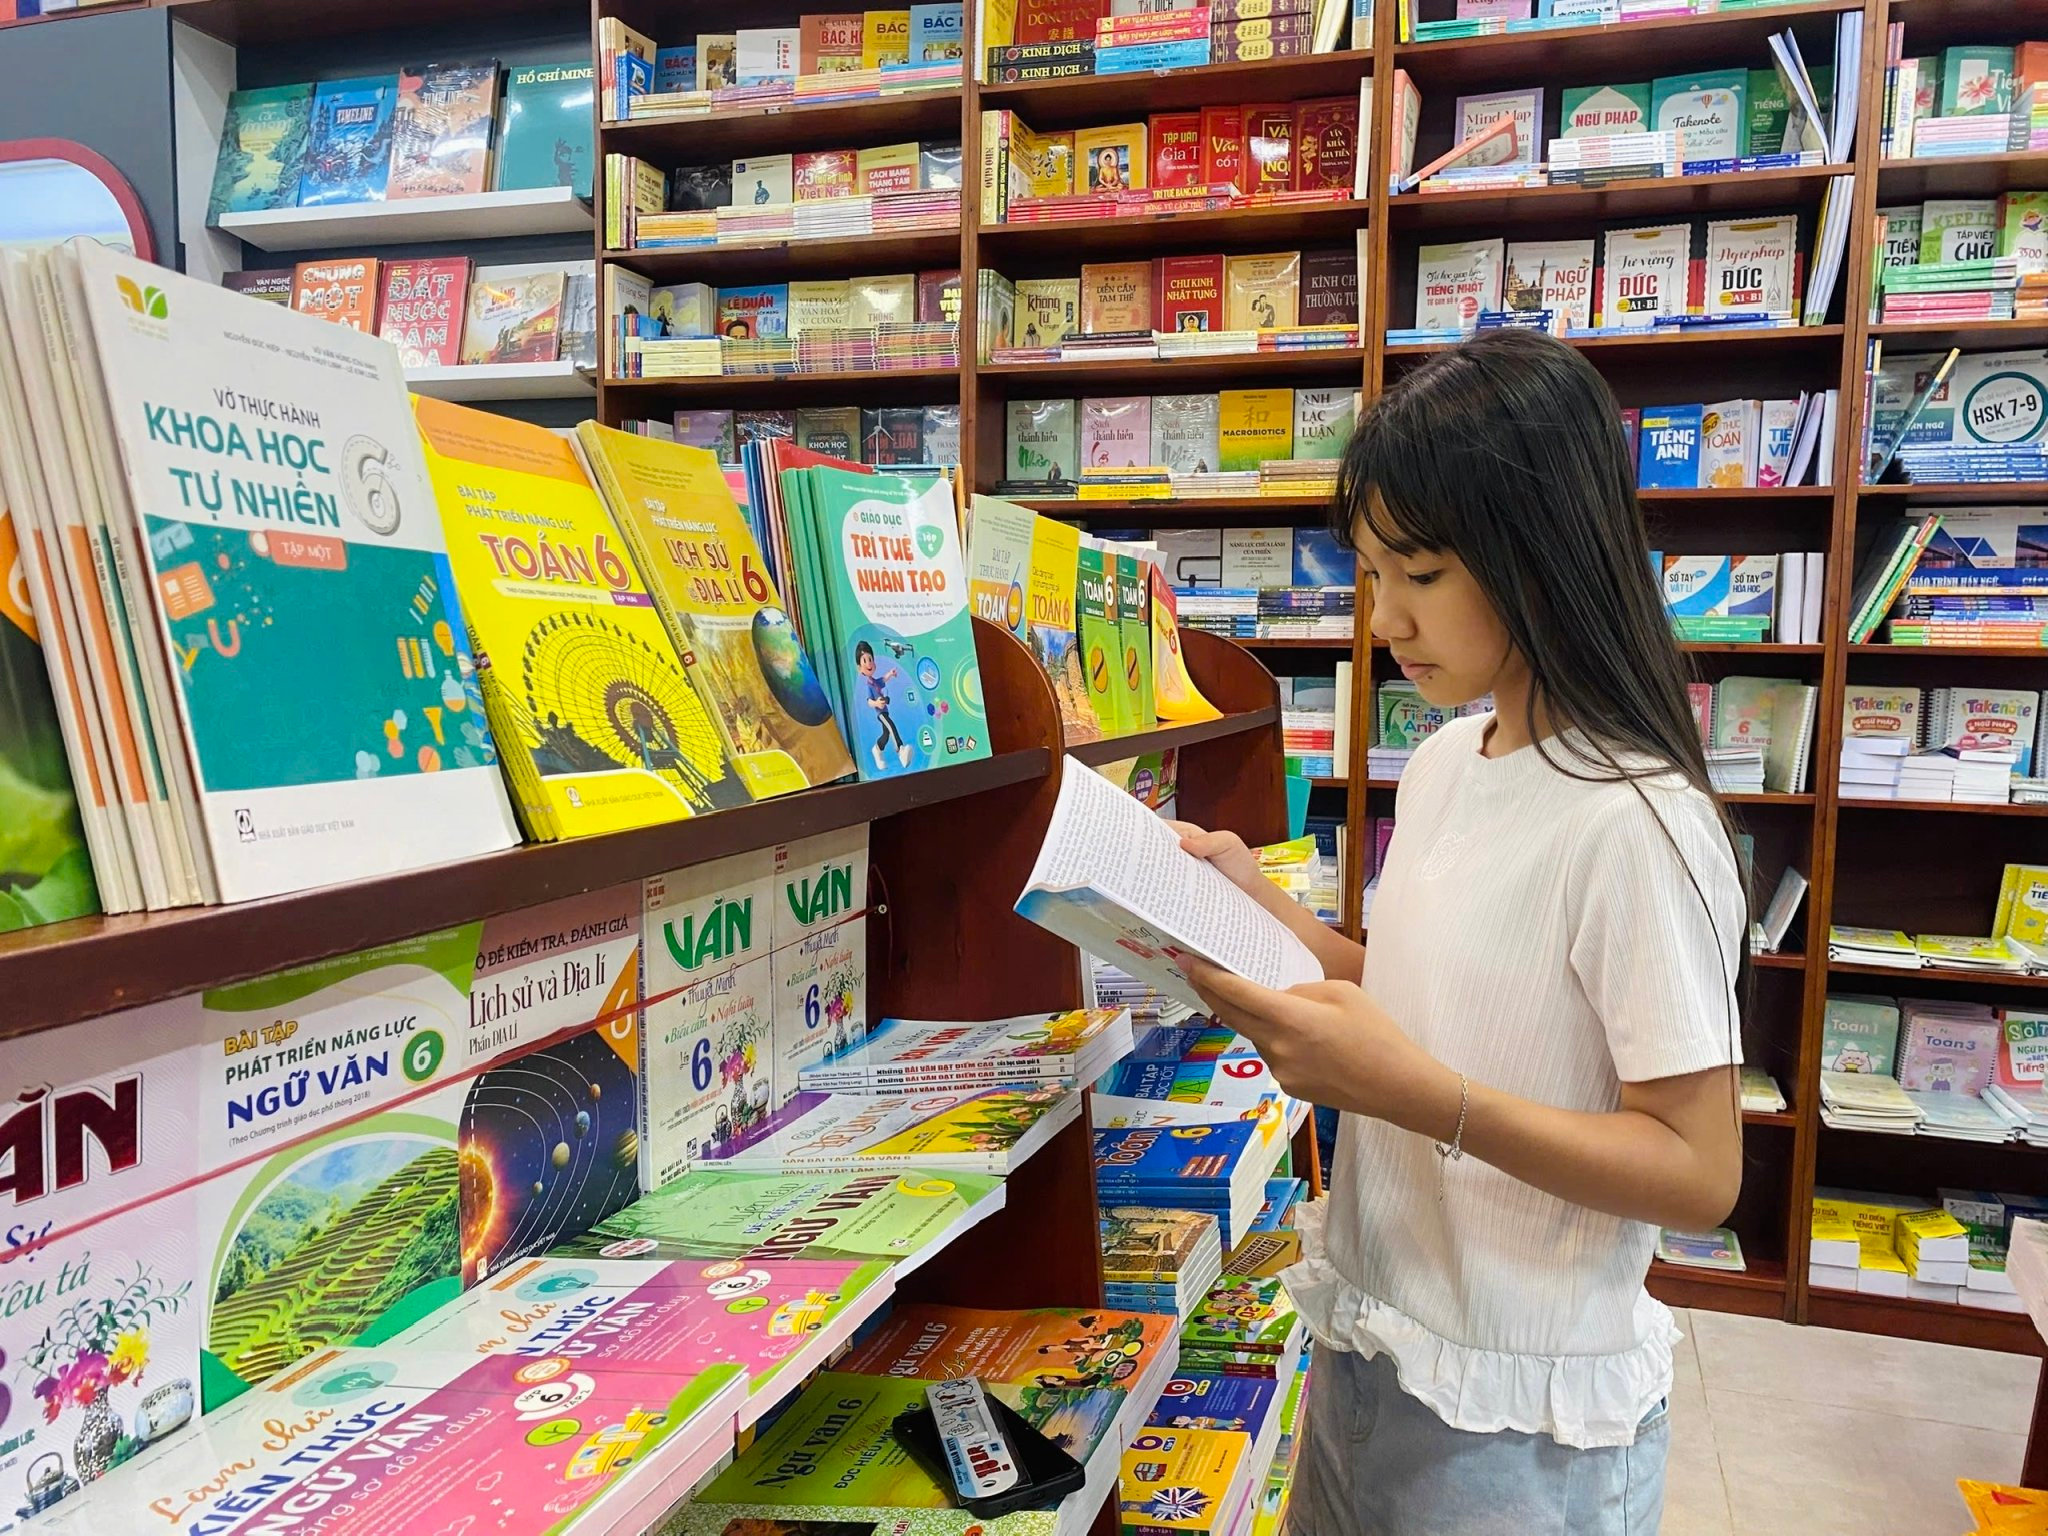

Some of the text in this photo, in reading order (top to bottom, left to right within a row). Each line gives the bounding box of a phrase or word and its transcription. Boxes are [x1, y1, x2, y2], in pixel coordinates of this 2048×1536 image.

[877, 23, 907, 33] BÁC
[924, 17, 954, 28] BÁC
[1022, 45, 1080, 58] KINH DỊCH
[1021, 65, 1080, 78] KINH DỊCH
[336, 106, 374, 124] TIMELINE
[1467, 114, 1500, 125] Mind
[1673, 115, 1722, 128] Takenote
[1161, 147, 1186, 161] Gia
[1932, 212, 1973, 229] KEEP
[1955, 241, 1993, 261] CHỮ
[2018, 247, 2041, 258] 3500
[303, 263, 365, 283] CHUNG
[1171, 277, 1213, 289] CHƯ KINH
[1312, 276, 1338, 288] KINH
[1555, 268, 1589, 284] NGỮ
[1722, 266, 1762, 290] ĐỨC
[1546, 285, 1586, 303] PHÁP
[1619, 272, 1657, 296] ĐỨC
[300, 286, 363, 315] MỘT
[821, 297, 842, 305] NAM
[1167, 289, 1217, 302] NHẬT TỤNG
[213, 388, 321, 428] VỞ THỰC HÀNH
[1303, 393, 1331, 406] ANH
[1973, 394, 2037, 425] HSK 7-9
[1245, 408, 1270, 427] 和
[1302, 410, 1326, 425] LẠC
[144, 401, 331, 478] KHOA HỌC
[1222, 428, 1286, 437] MACROBIOTICS
[1302, 422, 1335, 439] LUẬN
[1651, 428, 1695, 446] TIẾNG
[809, 440, 847, 450] KHOA HỌC
[1656, 444, 1688, 460] ANH
[342, 434, 400, 536] 6
[457, 486, 496, 503] BÀI TẬP
[169, 467, 341, 528] TỰ NHIÊN
[466, 505, 494, 519] PHÁT
[495, 509, 526, 524] TRIỂN
[860, 508, 902, 528] GIÁO DỤC
[280, 541, 332, 561] TẬP MỘT
[850, 531, 914, 564] TRÍ TUỆ
[479, 532, 630, 591] TOÁN 6
[741, 554, 769, 604] 6
[857, 566, 946, 596] NHÂN TẠO
[1083, 575, 1114, 607] TOÁN 6
[1122, 579, 1145, 609] TOÁN 6
[1032, 593, 1070, 624] TOÁN 6
[1852, 695, 1913, 714] Takenote
[1966, 698, 2031, 717] Takenote
[1400, 707, 1444, 726] Tiếng
[1404, 719, 1438, 734] Anh
[786, 862, 853, 928] VĂN
[487, 949, 504, 968] ĐỀ
[505, 937, 540, 961] KIỂM
[541, 931, 569, 953] TRA,
[569, 920, 607, 945] ĐÁNH
[609, 914, 630, 936] GIÁ
[663, 896, 754, 973] VĂN
[468, 954, 607, 1029] Lịch sử và Địa lí
[610, 989, 634, 1041] 6
[805, 983, 820, 1029] 6
[223, 1019, 299, 1057] BÀI TẬP
[224, 1015, 417, 1085] PHÁT TRIỂN NĂNG LỰC
[691, 1038, 713, 1092] 6
[1222, 1060, 1263, 1079] 6
[877, 1076, 904, 1084] Những
[905, 1074, 919, 1083] BÀI
[921, 1074, 936, 1082] VĂN
[955, 1071, 977, 1080] ĐIỂM
[227, 1047, 434, 1130] NGỮ VĂN 6
[229, 1134, 248, 1148] (Theo
[250, 1124, 276, 1140] Chương
[277, 1117, 293, 1130] trình
[309, 1108, 320, 1118] dục
[354, 1090, 371, 1102] 2018)
[896, 1178, 956, 1197] 6
[748, 1216, 839, 1261] NGỮ
[807, 1175, 900, 1213] VĂN
[56, 1253, 92, 1296] tả
[529, 1295, 615, 1343] THỨC
[583, 1302, 655, 1338] VĂN
[597, 1344, 618, 1358] sơ
[616, 1329, 641, 1343] đồ
[655, 1294, 690, 1315] duy
[904, 1322, 948, 1357] văn 6
[540, 1388, 564, 1404] 6
[350, 1406, 493, 1501] sơ đồ tư duy
[753, 1399, 862, 1489] Ngữ văn 6
[188, 1473, 295, 1536] KIẾN
[279, 1400, 406, 1468] THỨC
[243, 1413, 448, 1536] NGỮ VĂN
[833, 1444, 882, 1489] ĐỌC HIỂU
